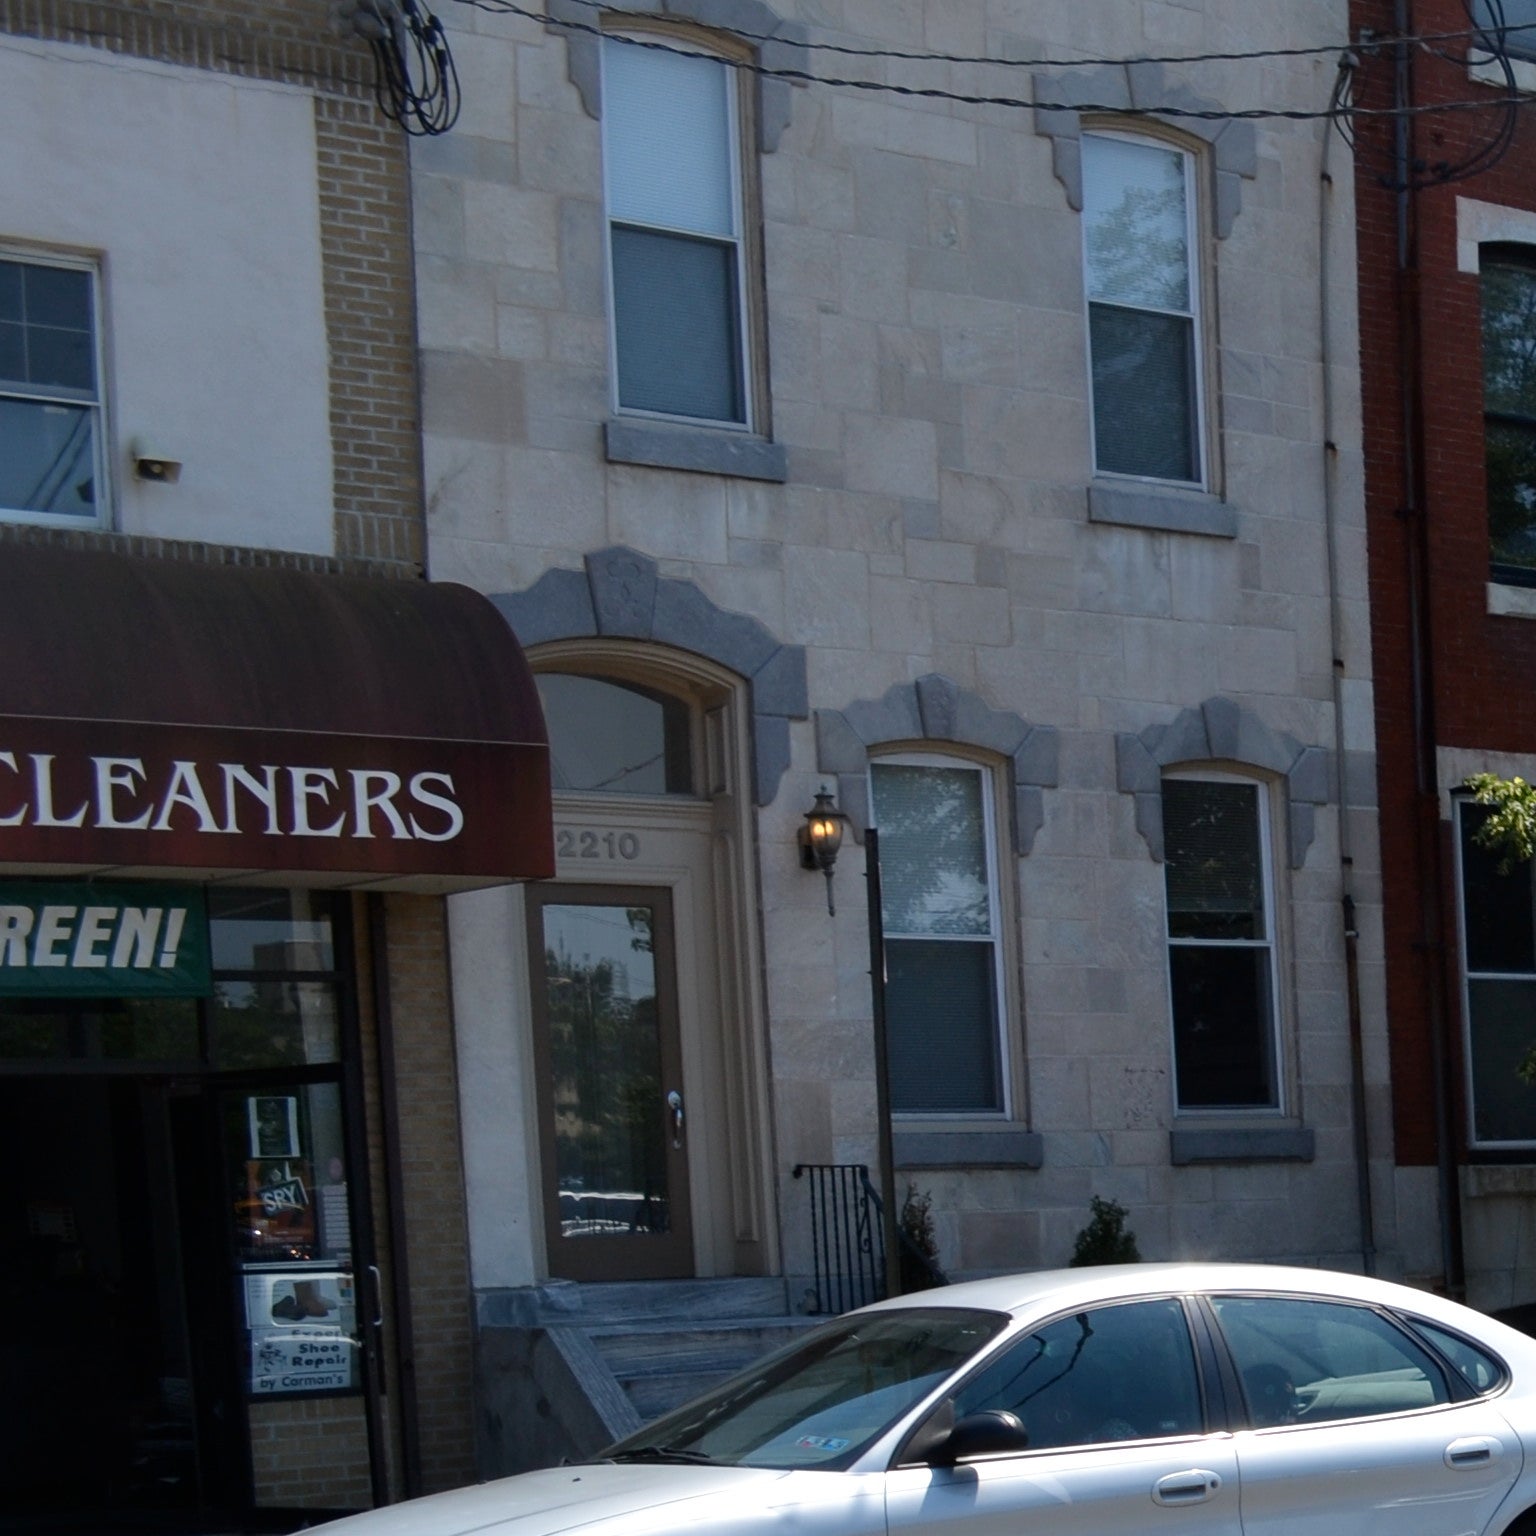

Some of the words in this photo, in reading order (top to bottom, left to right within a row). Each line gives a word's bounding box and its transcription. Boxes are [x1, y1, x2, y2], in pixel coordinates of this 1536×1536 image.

[557, 829, 640, 860] 2210
[299, 1343, 340, 1354] Shoe
[291, 1355, 347, 1369] Repair
[260, 1379, 277, 1390] by
[281, 1373, 344, 1387] Carman's
